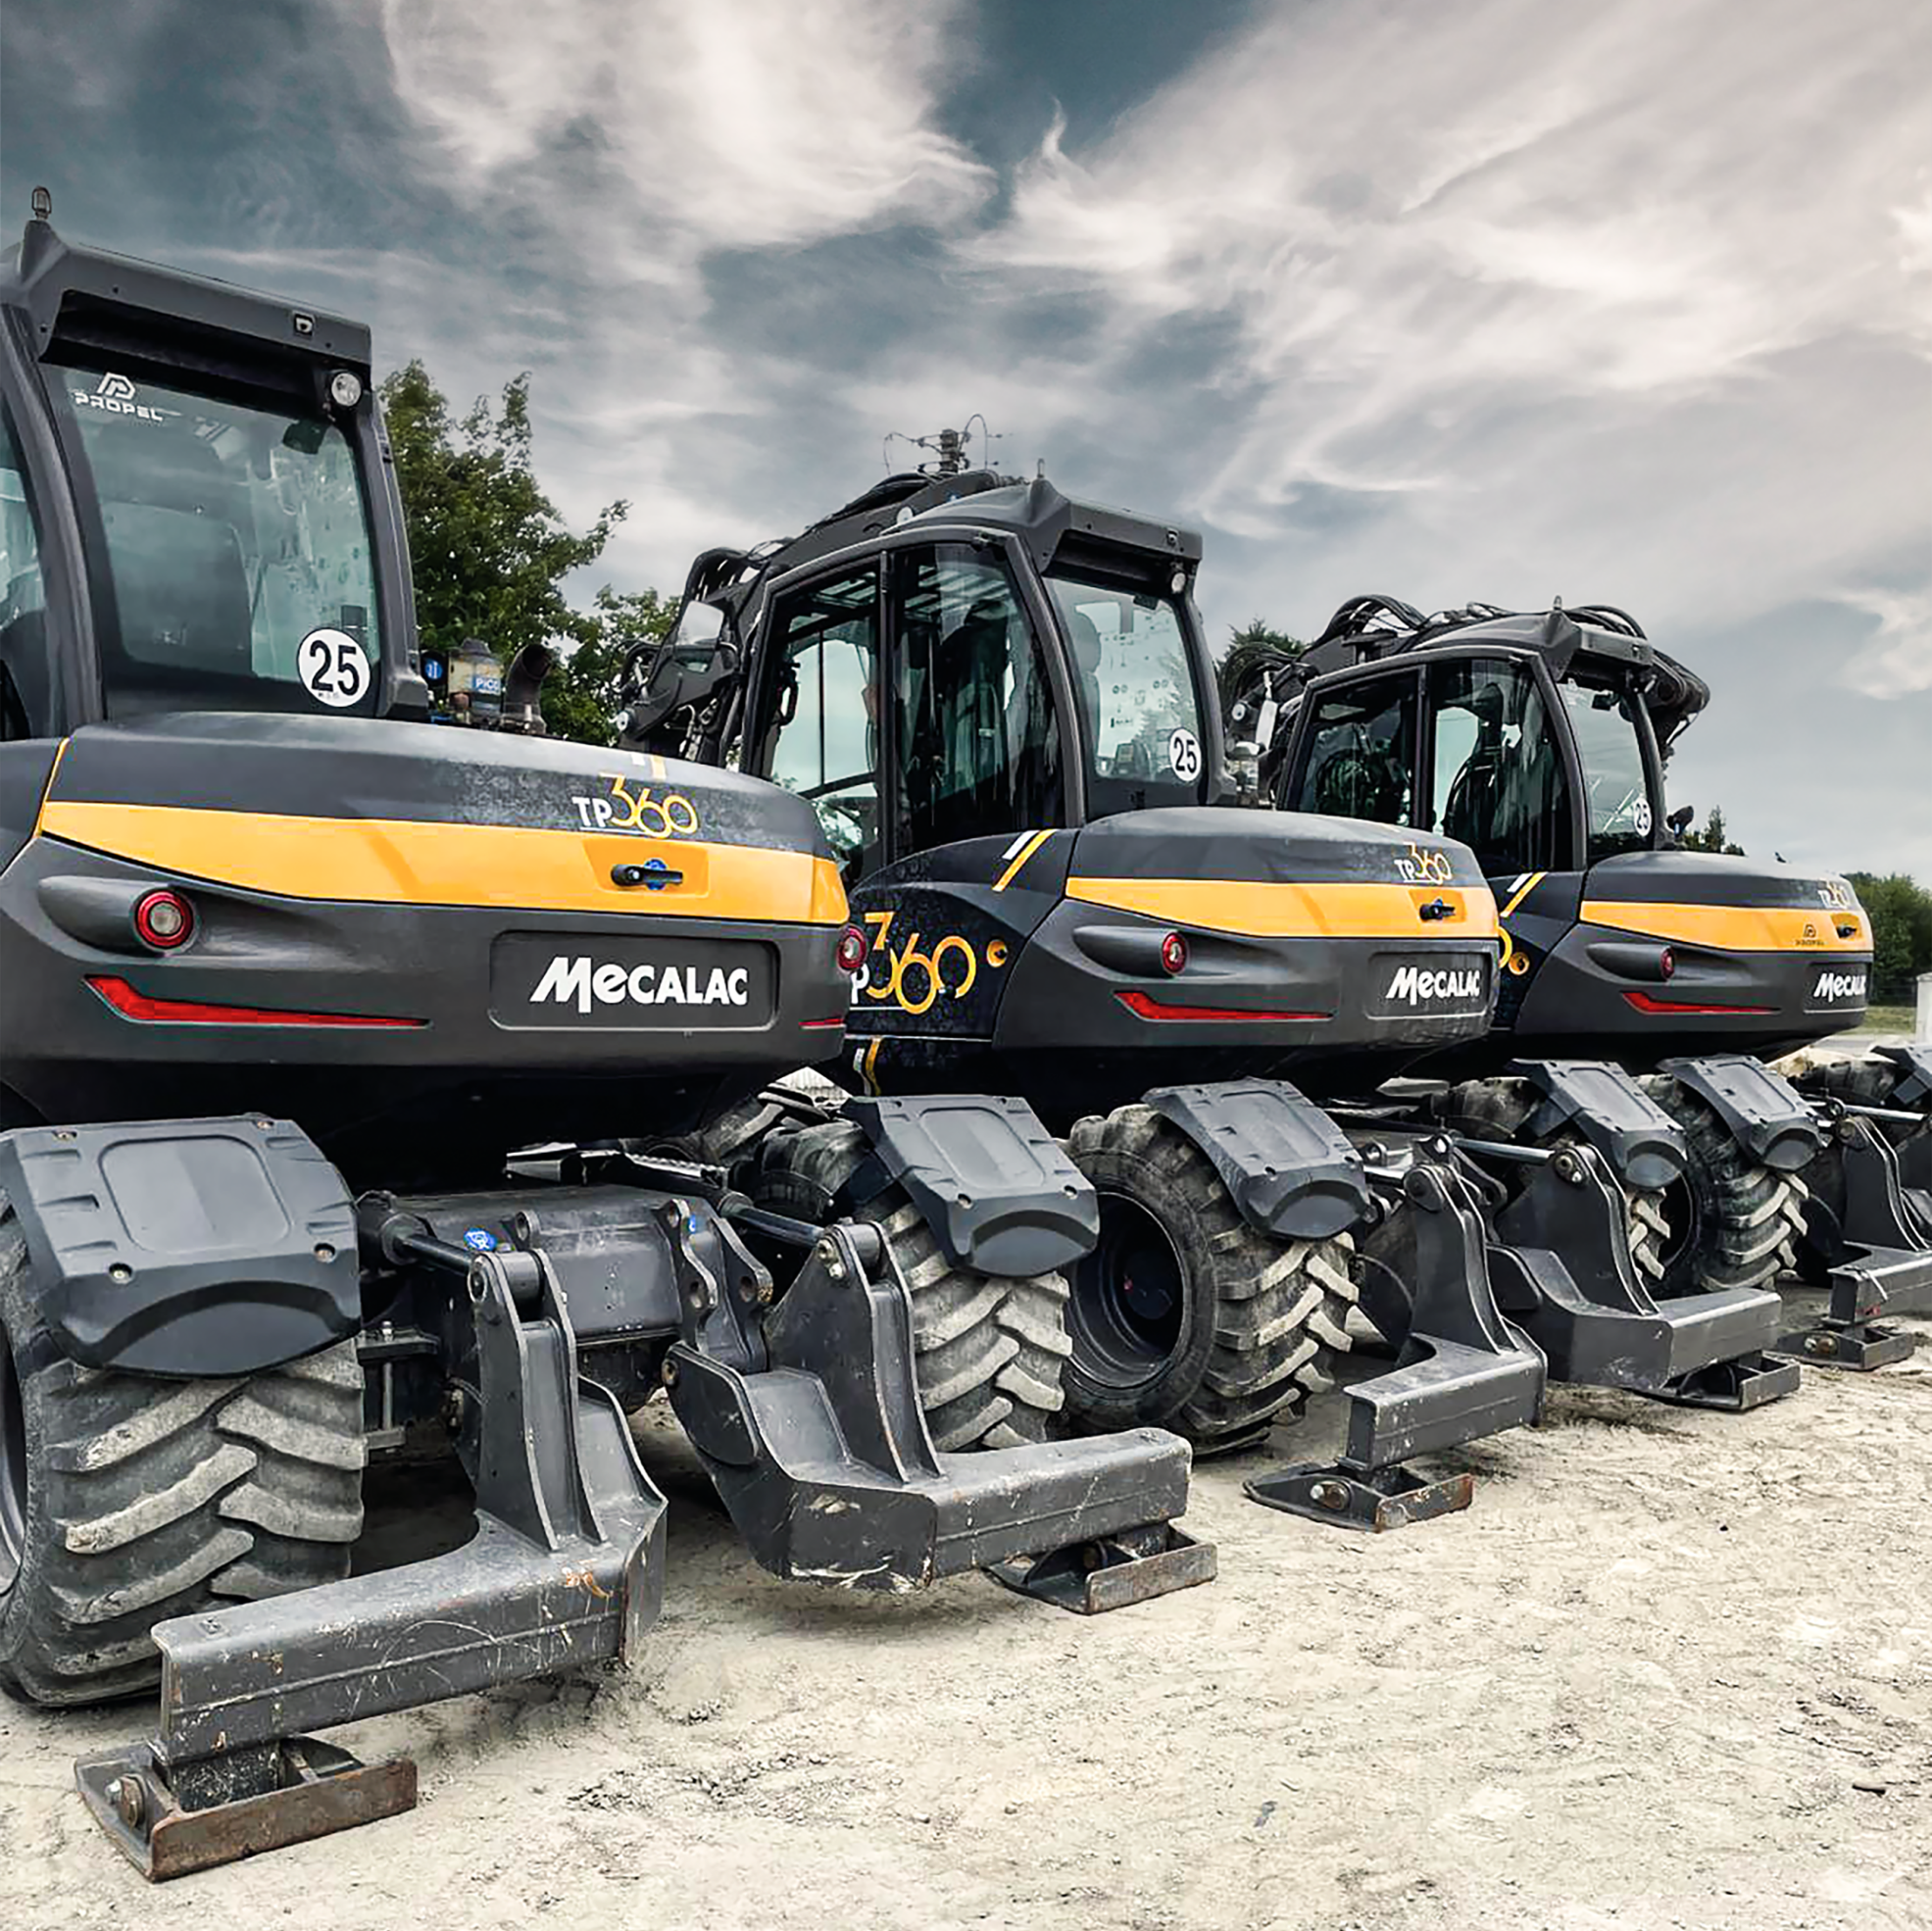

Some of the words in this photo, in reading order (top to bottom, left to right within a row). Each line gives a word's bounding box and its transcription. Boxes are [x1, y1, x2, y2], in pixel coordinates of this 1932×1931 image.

[74, 392, 164, 421] PROPEL
[310, 639, 360, 696] 25
[1174, 737, 1198, 773] 25
[571, 771, 698, 839] TP360
[1394, 842, 1453, 885] TP360
